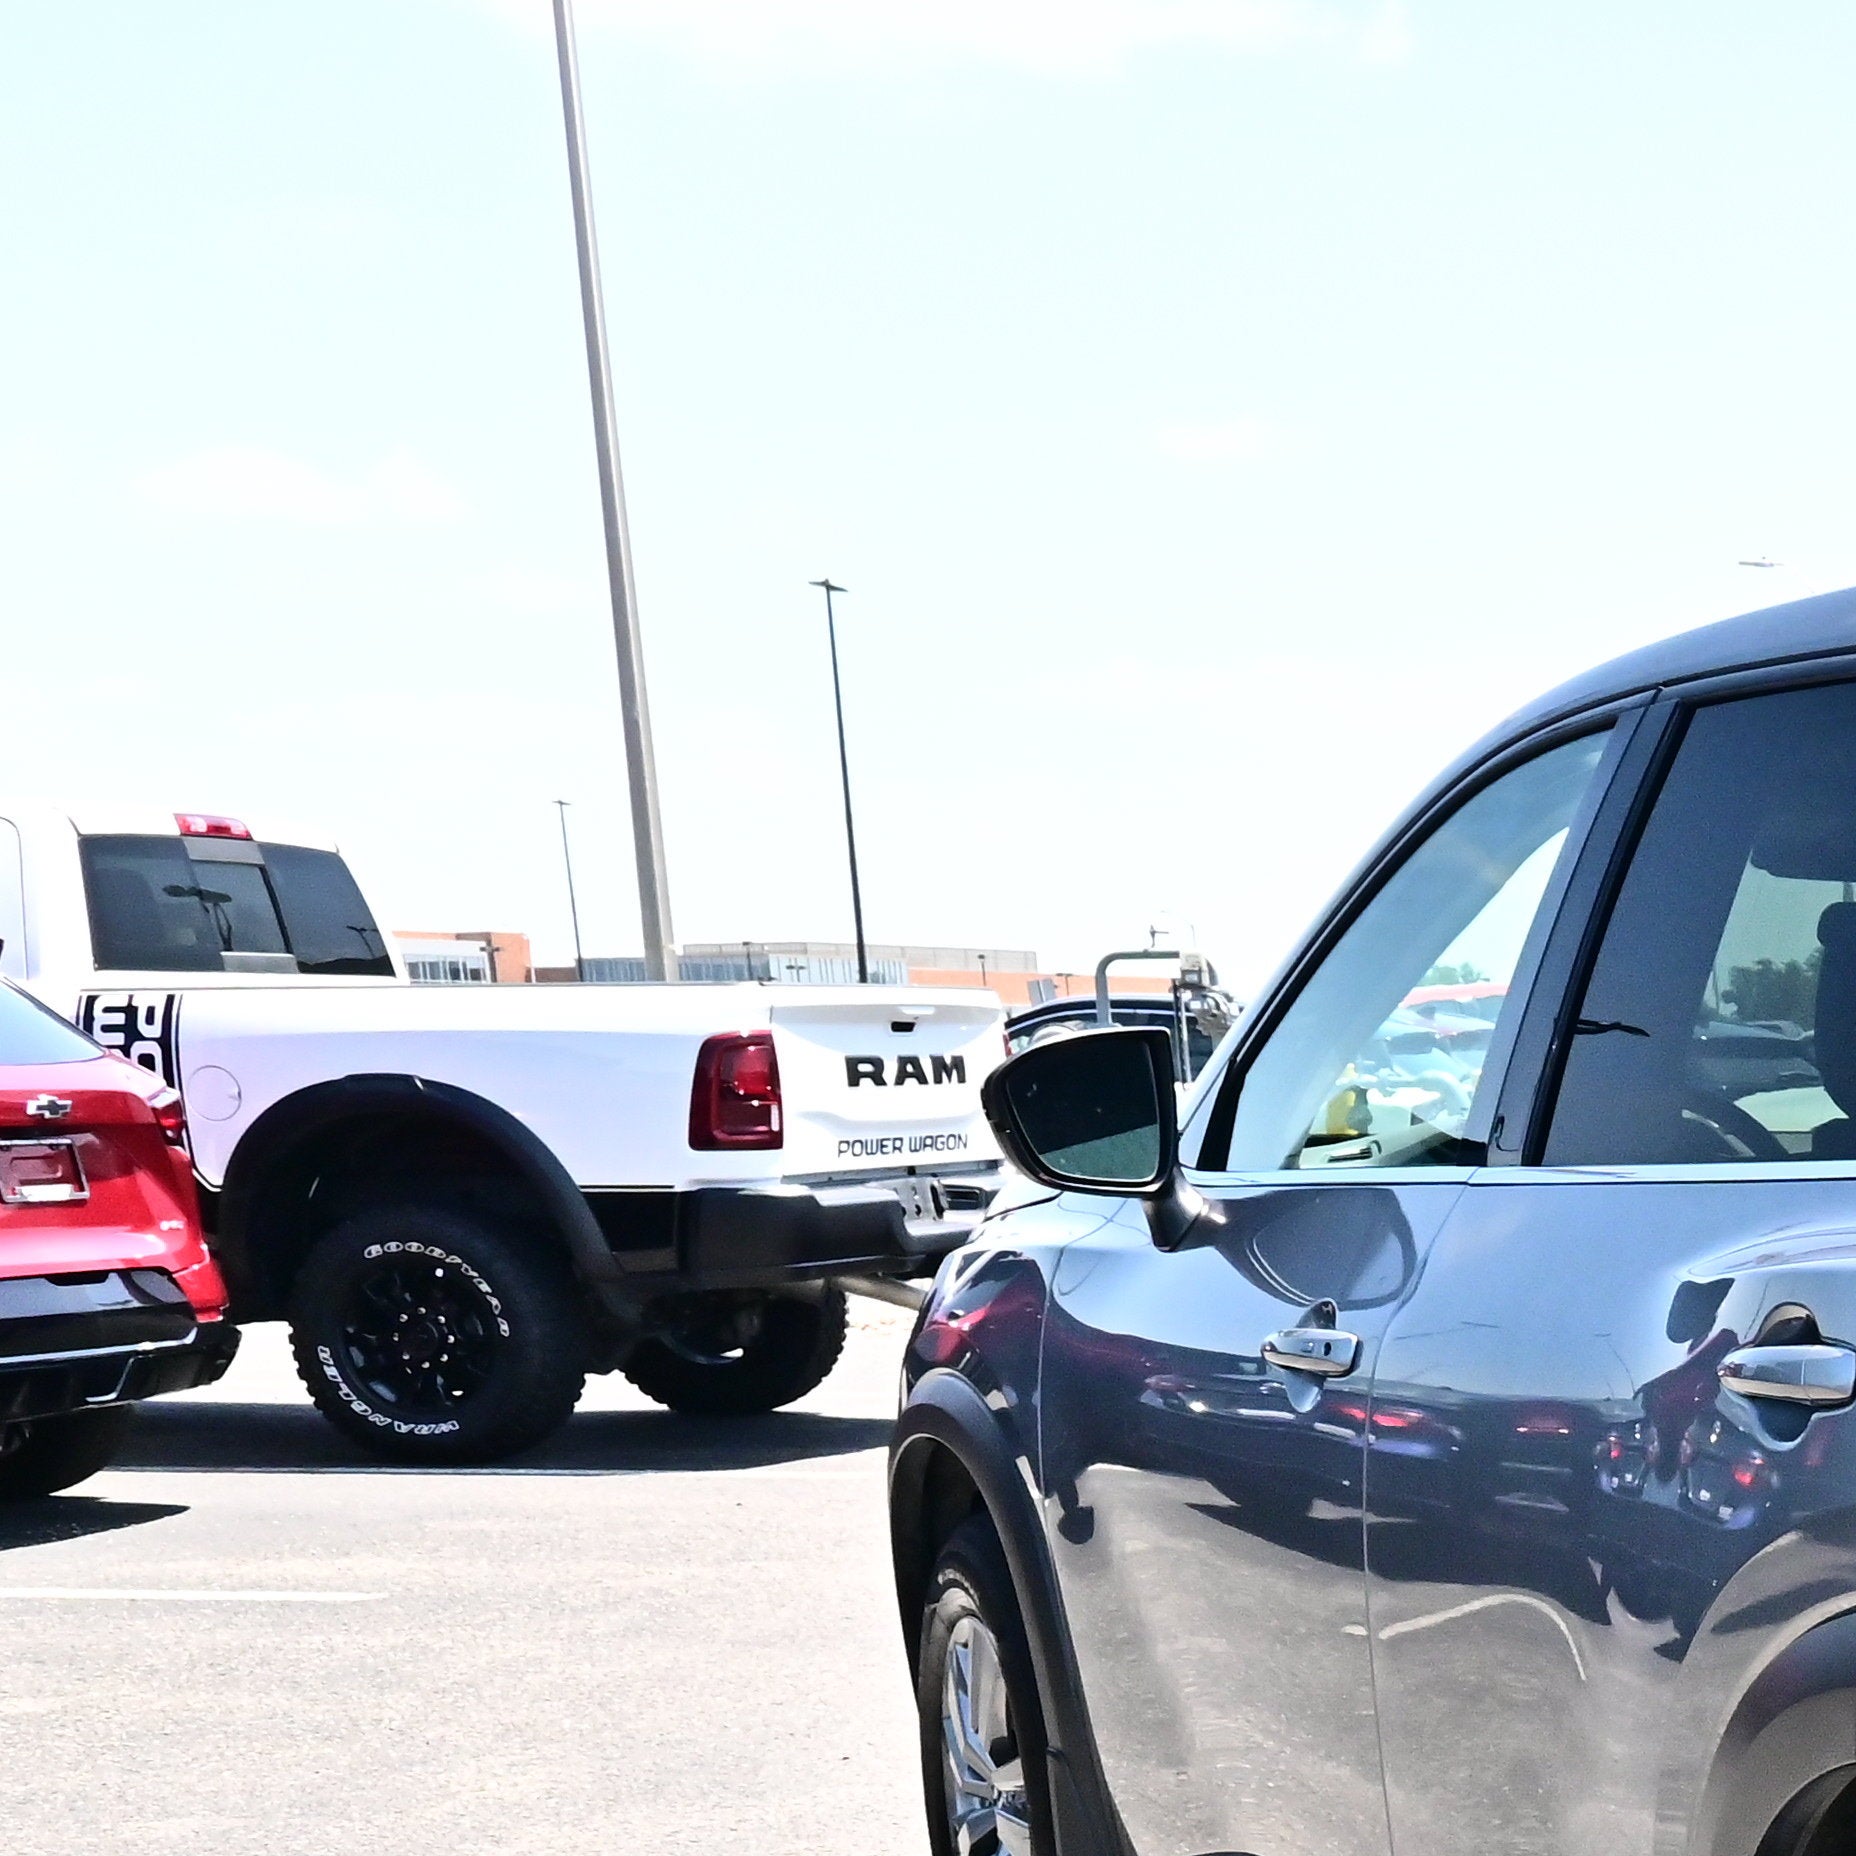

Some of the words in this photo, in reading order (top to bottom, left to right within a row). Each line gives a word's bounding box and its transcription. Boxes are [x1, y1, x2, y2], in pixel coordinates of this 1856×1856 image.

[845, 1055, 966, 1087] RAM
[838, 1137, 904, 1157] POWER
[909, 1133, 968, 1153] WAGON
[364, 1241, 510, 1337] GOODYEAR
